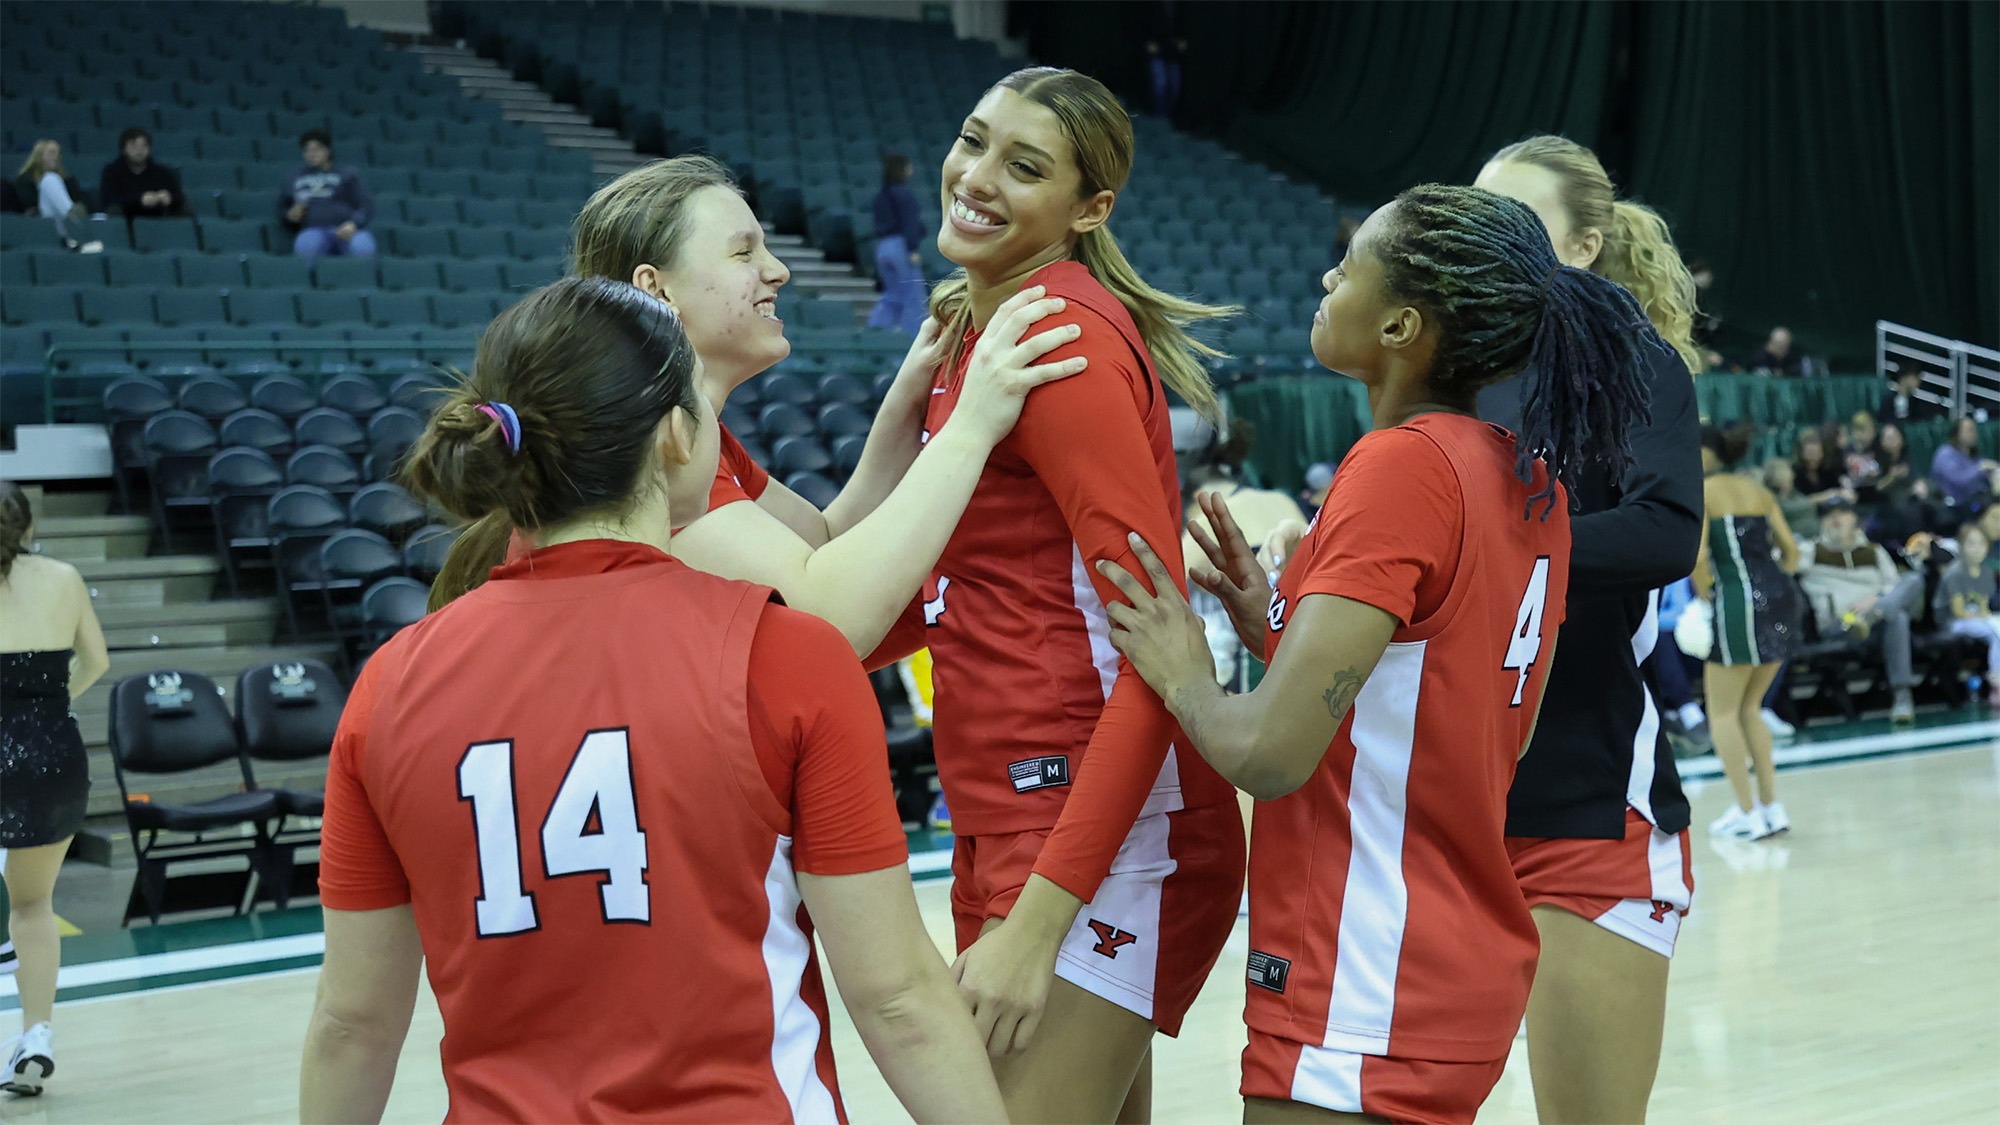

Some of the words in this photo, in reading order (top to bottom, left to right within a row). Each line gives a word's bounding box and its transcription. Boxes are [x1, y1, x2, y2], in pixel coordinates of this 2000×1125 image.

[1501, 555, 1550, 708] 4
[1047, 764, 1059, 778] M
[455, 726, 651, 939] 14
[1649, 899, 1674, 924] Y
[1087, 917, 1138, 960] Y
[1269, 966, 1280, 981] M
